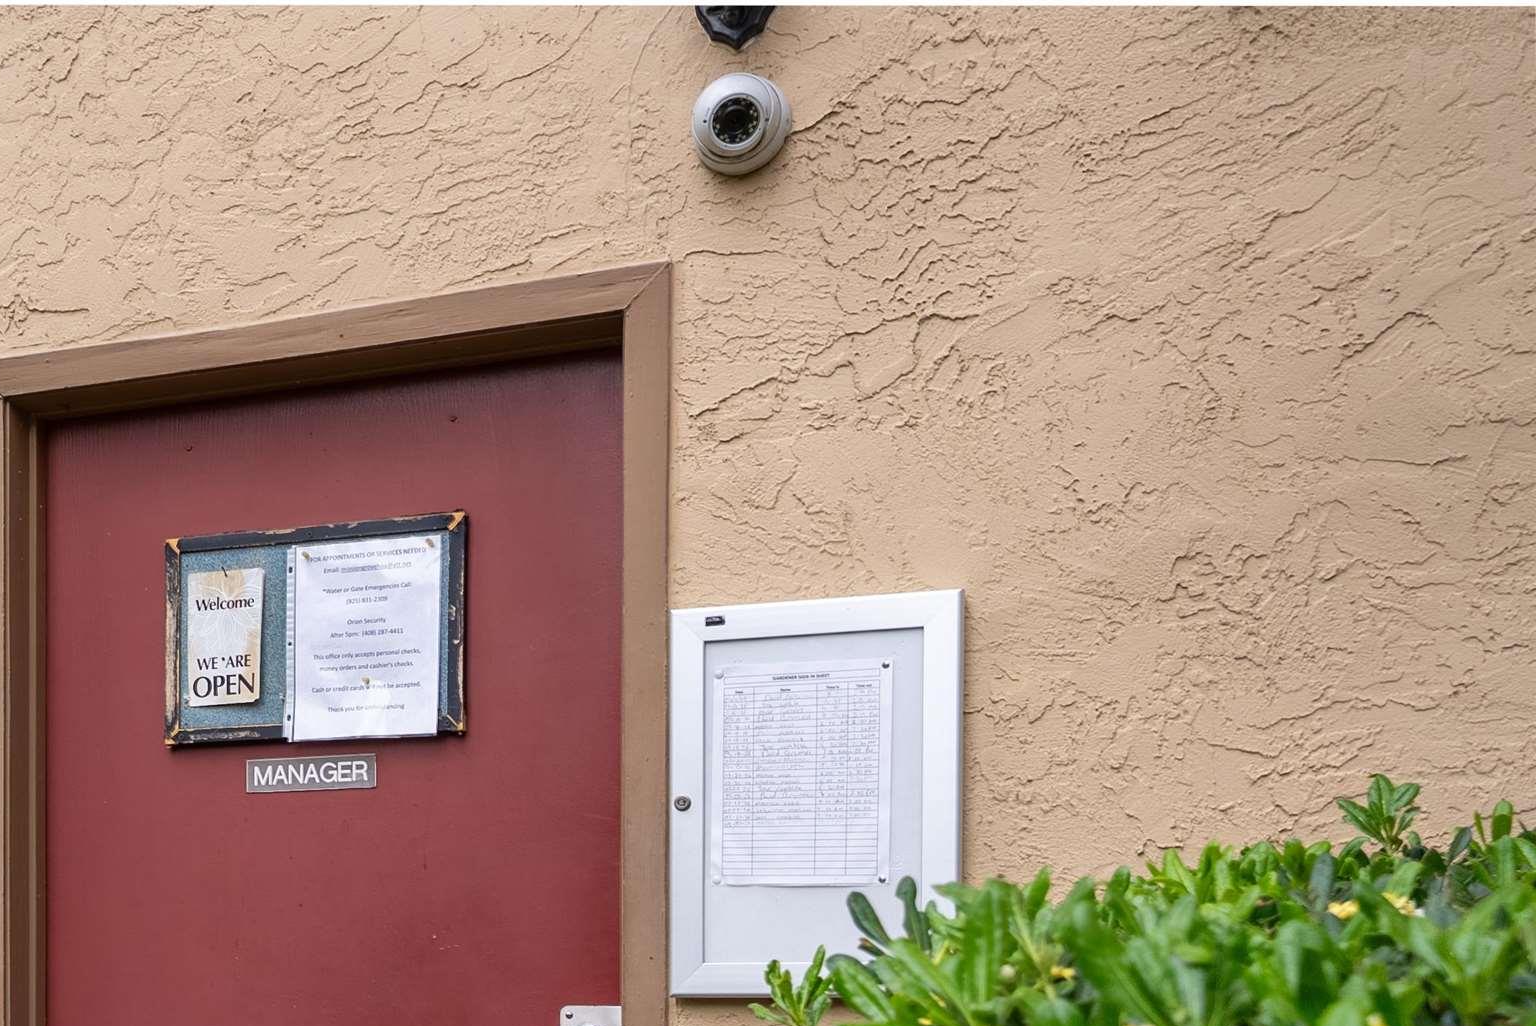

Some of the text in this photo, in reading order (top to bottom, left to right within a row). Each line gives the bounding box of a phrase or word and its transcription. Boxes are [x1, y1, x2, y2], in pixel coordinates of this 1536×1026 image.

[365, 583, 399, 592] Emergencies
[196, 596, 255, 612] Welcome
[197, 654, 251, 670] WE ARE
[342, 652, 353, 660] only
[355, 651, 375, 659] accepts
[376, 649, 399, 658] personal
[193, 673, 255, 698] OPEN
[253, 761, 368, 786] MANAGER
